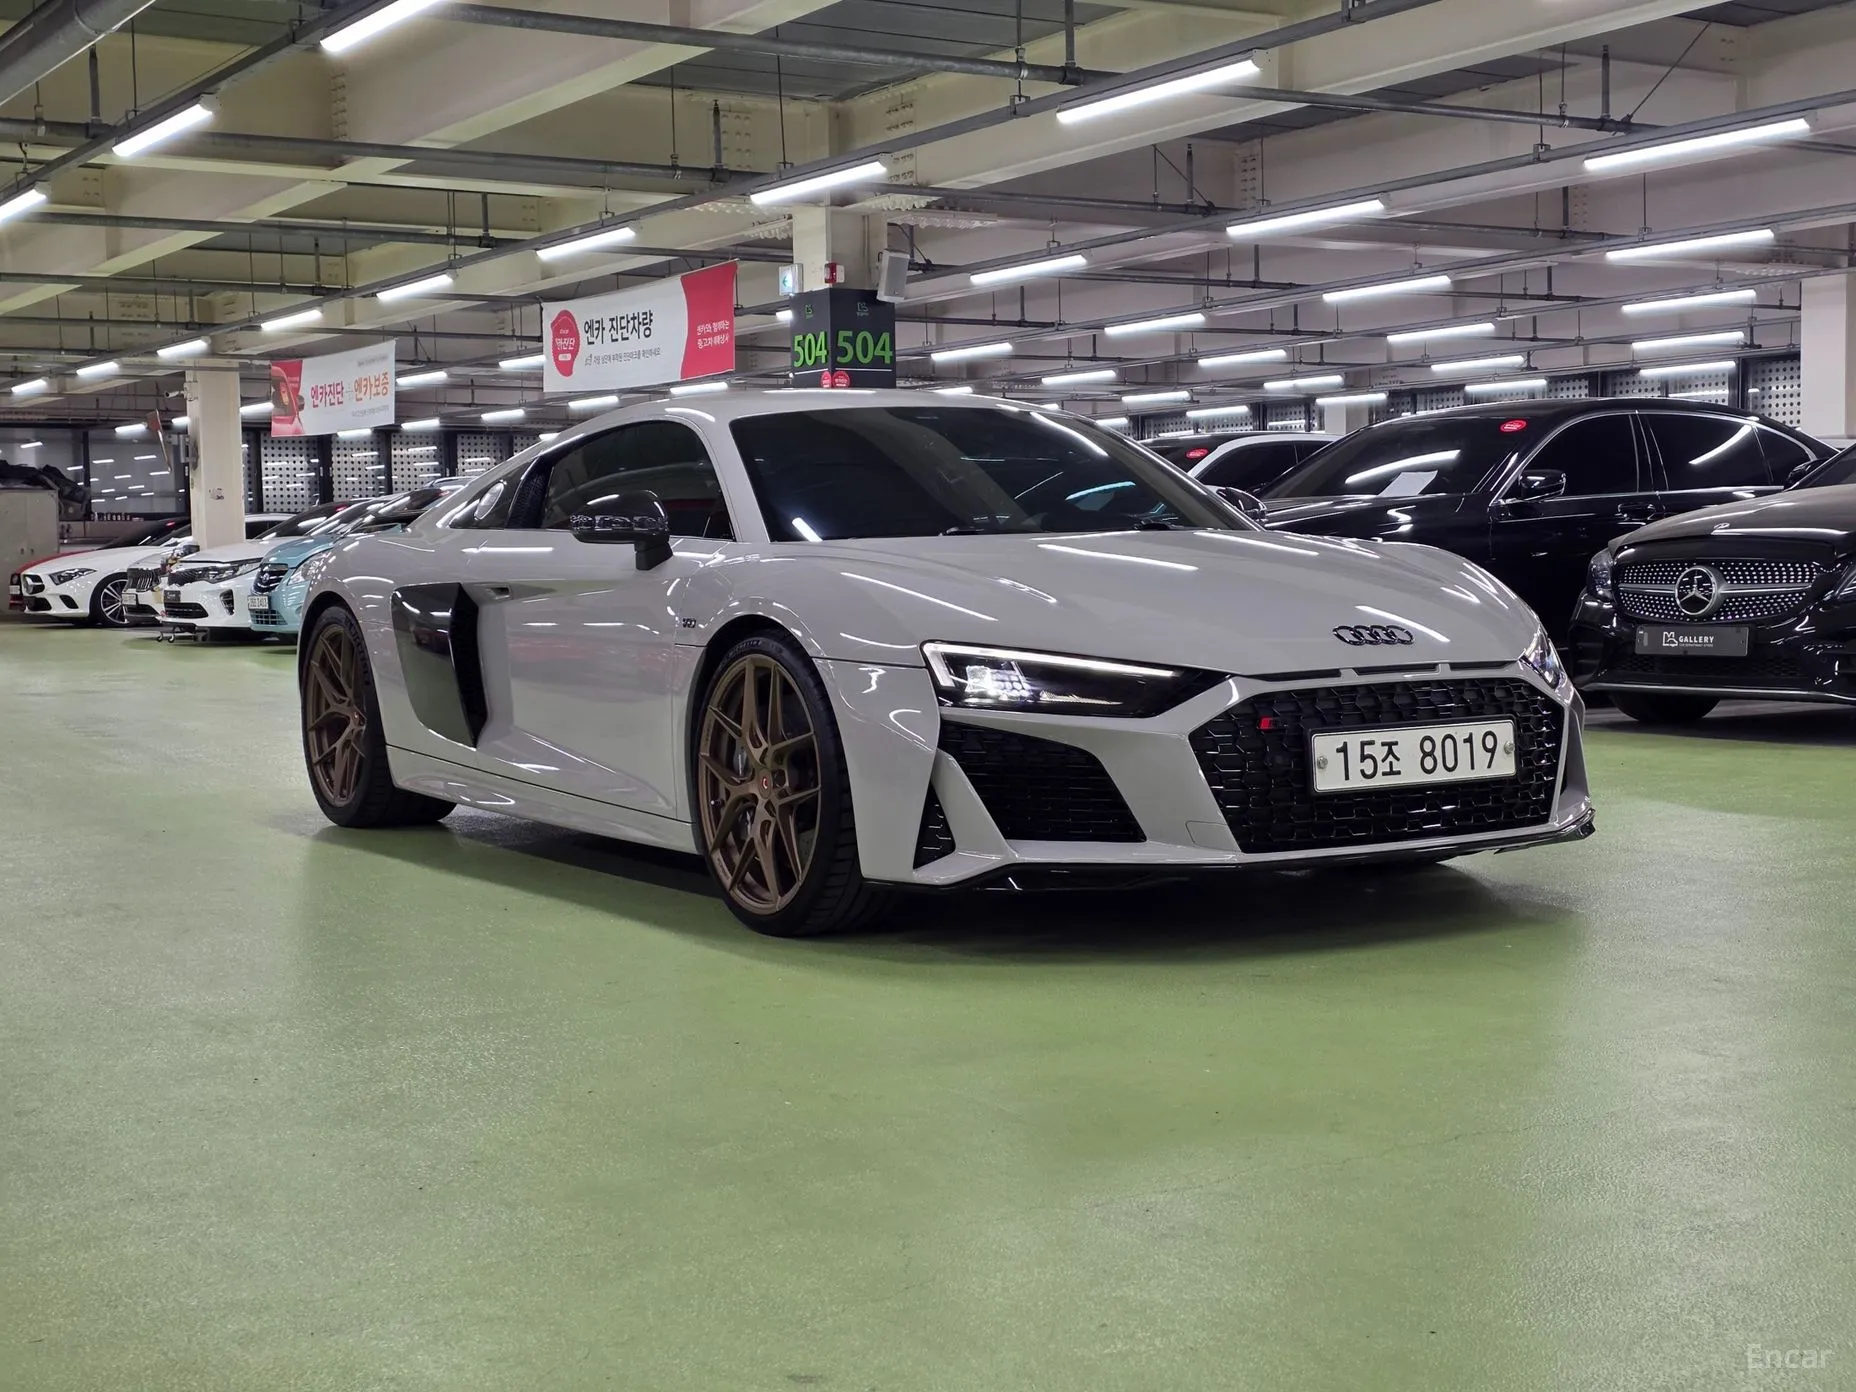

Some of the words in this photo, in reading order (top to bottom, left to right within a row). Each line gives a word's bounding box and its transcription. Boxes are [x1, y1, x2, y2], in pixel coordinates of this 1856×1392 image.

[584, 319, 605, 345] 엔카
[609, 310, 654, 342] 진단차량
[793, 331, 828, 368] 504
[837, 330, 893, 364] 504
[310, 380, 344, 408] 엔카진단
[354, 372, 390, 402] 엔카보증
[1335, 739, 1402, 781] 15조
[1419, 730, 1498, 775] 8019
